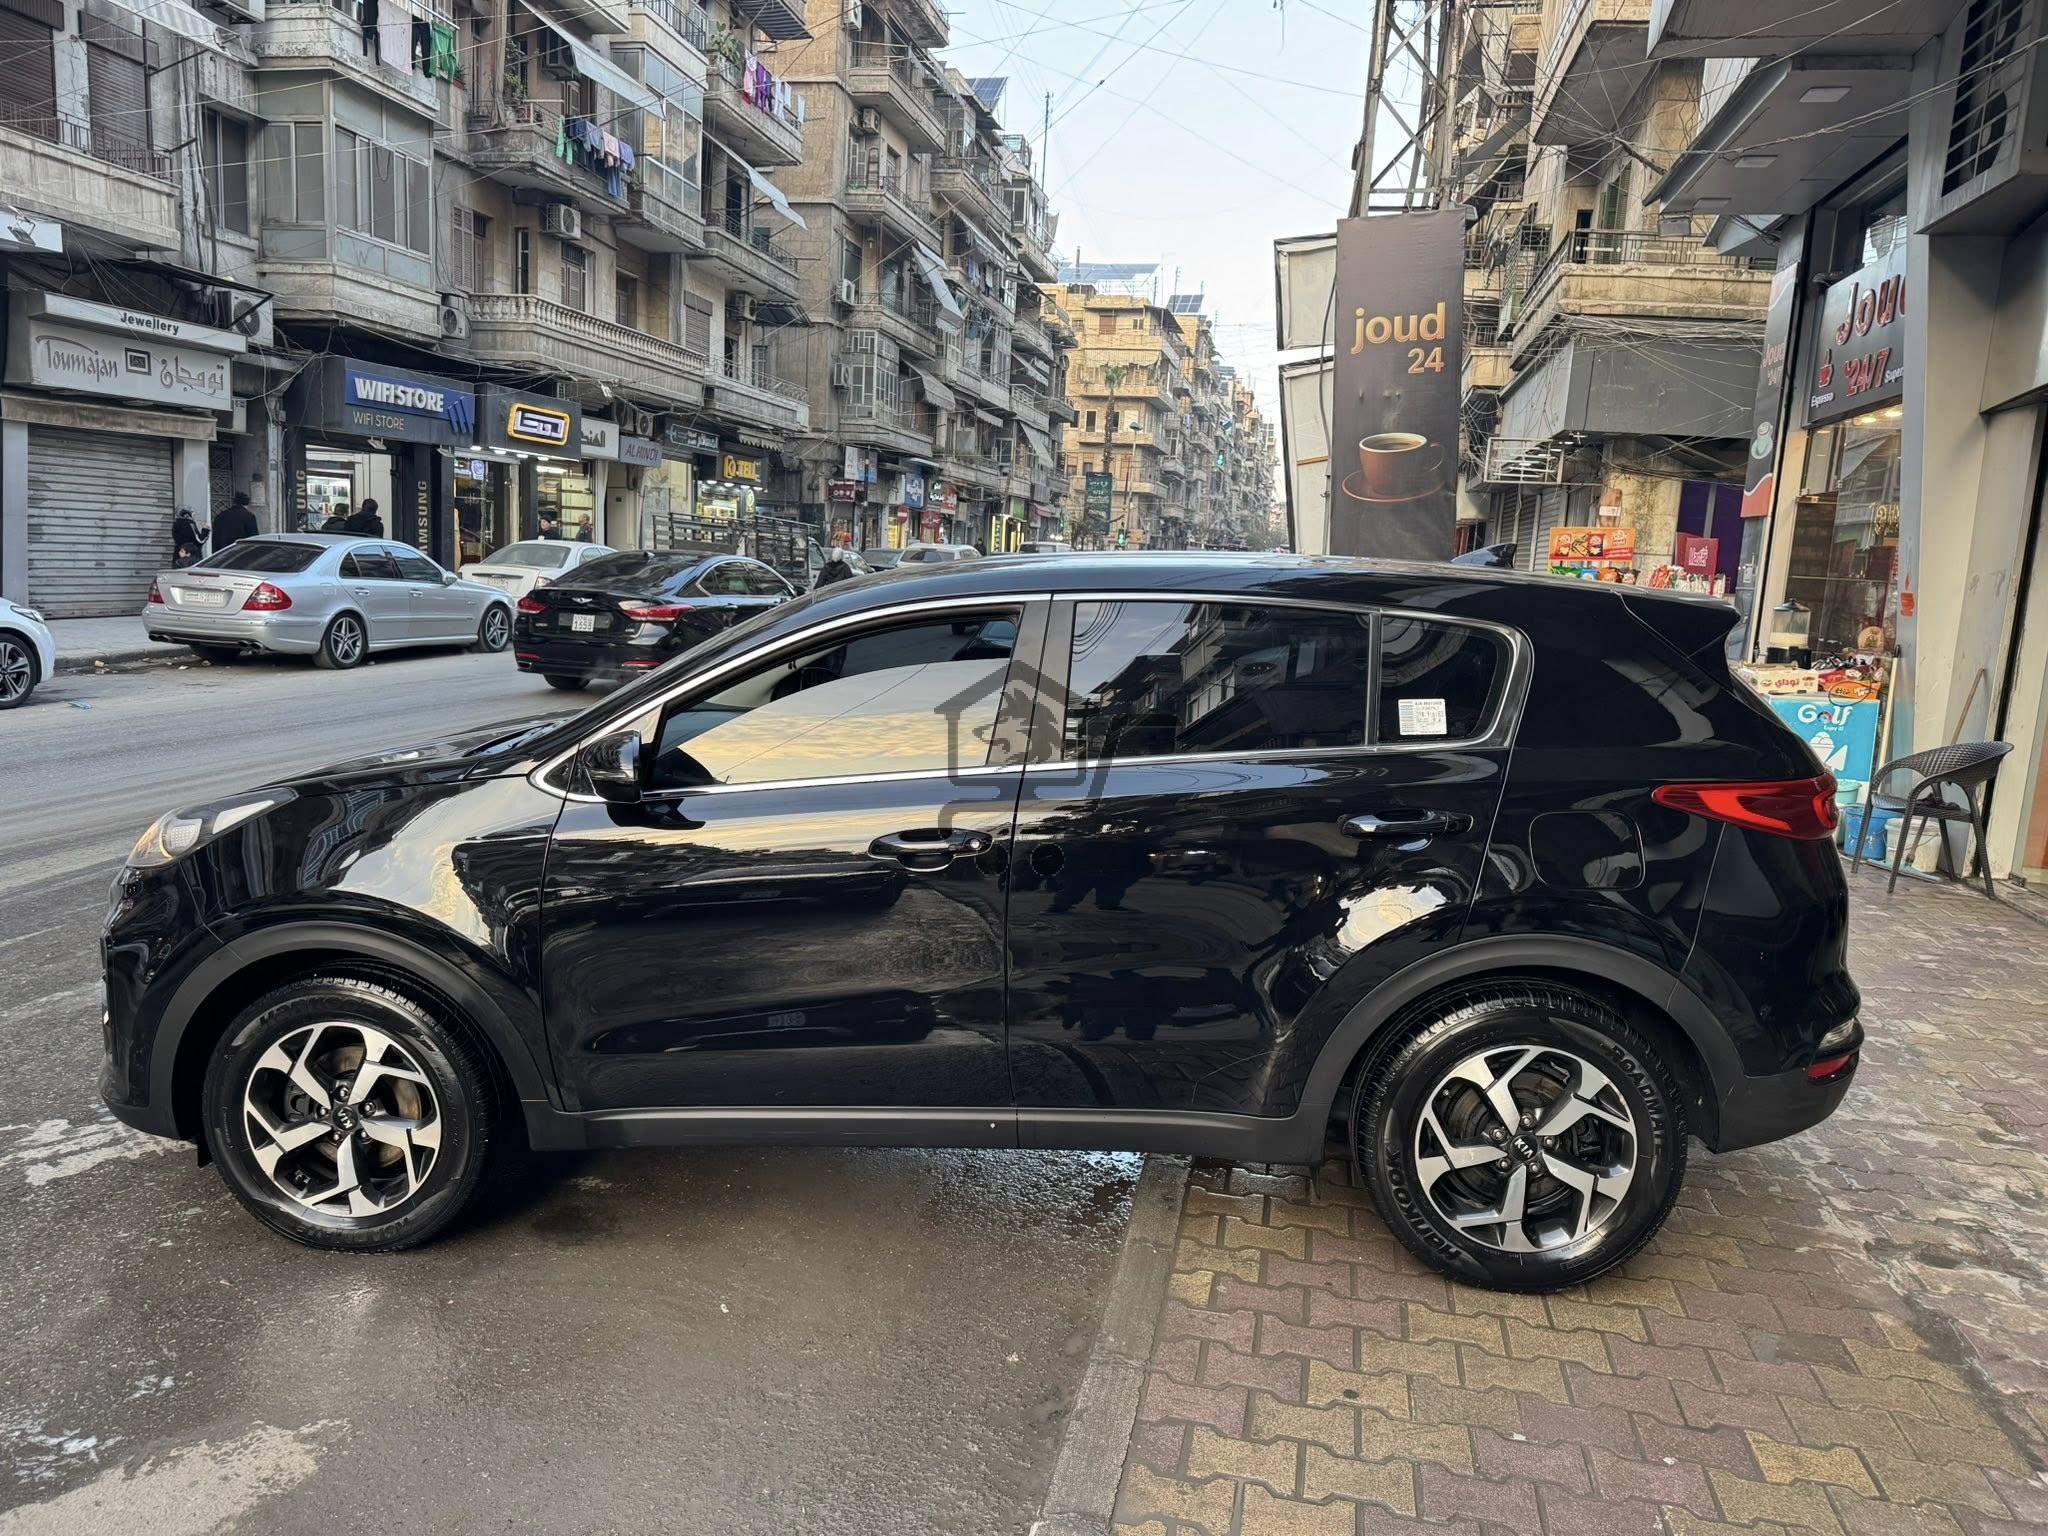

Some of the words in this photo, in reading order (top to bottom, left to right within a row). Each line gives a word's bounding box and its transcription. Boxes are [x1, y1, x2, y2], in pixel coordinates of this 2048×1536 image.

[120, 312, 180, 335] Jewellery
[1350, 301, 1446, 355] joud
[1835, 274, 1906, 346] Jou
[35, 334, 118, 383] Toumajan
[1407, 346, 1446, 374] 24
[1843, 347, 1891, 397] 24/7
[352, 410, 374, 426] WIFI
[375, 414, 405, 431] STORE
[418, 480, 428, 555] AMSUNG
[337, 1108, 354, 1129] KIA
[1514, 1138, 1535, 1159] KIA
